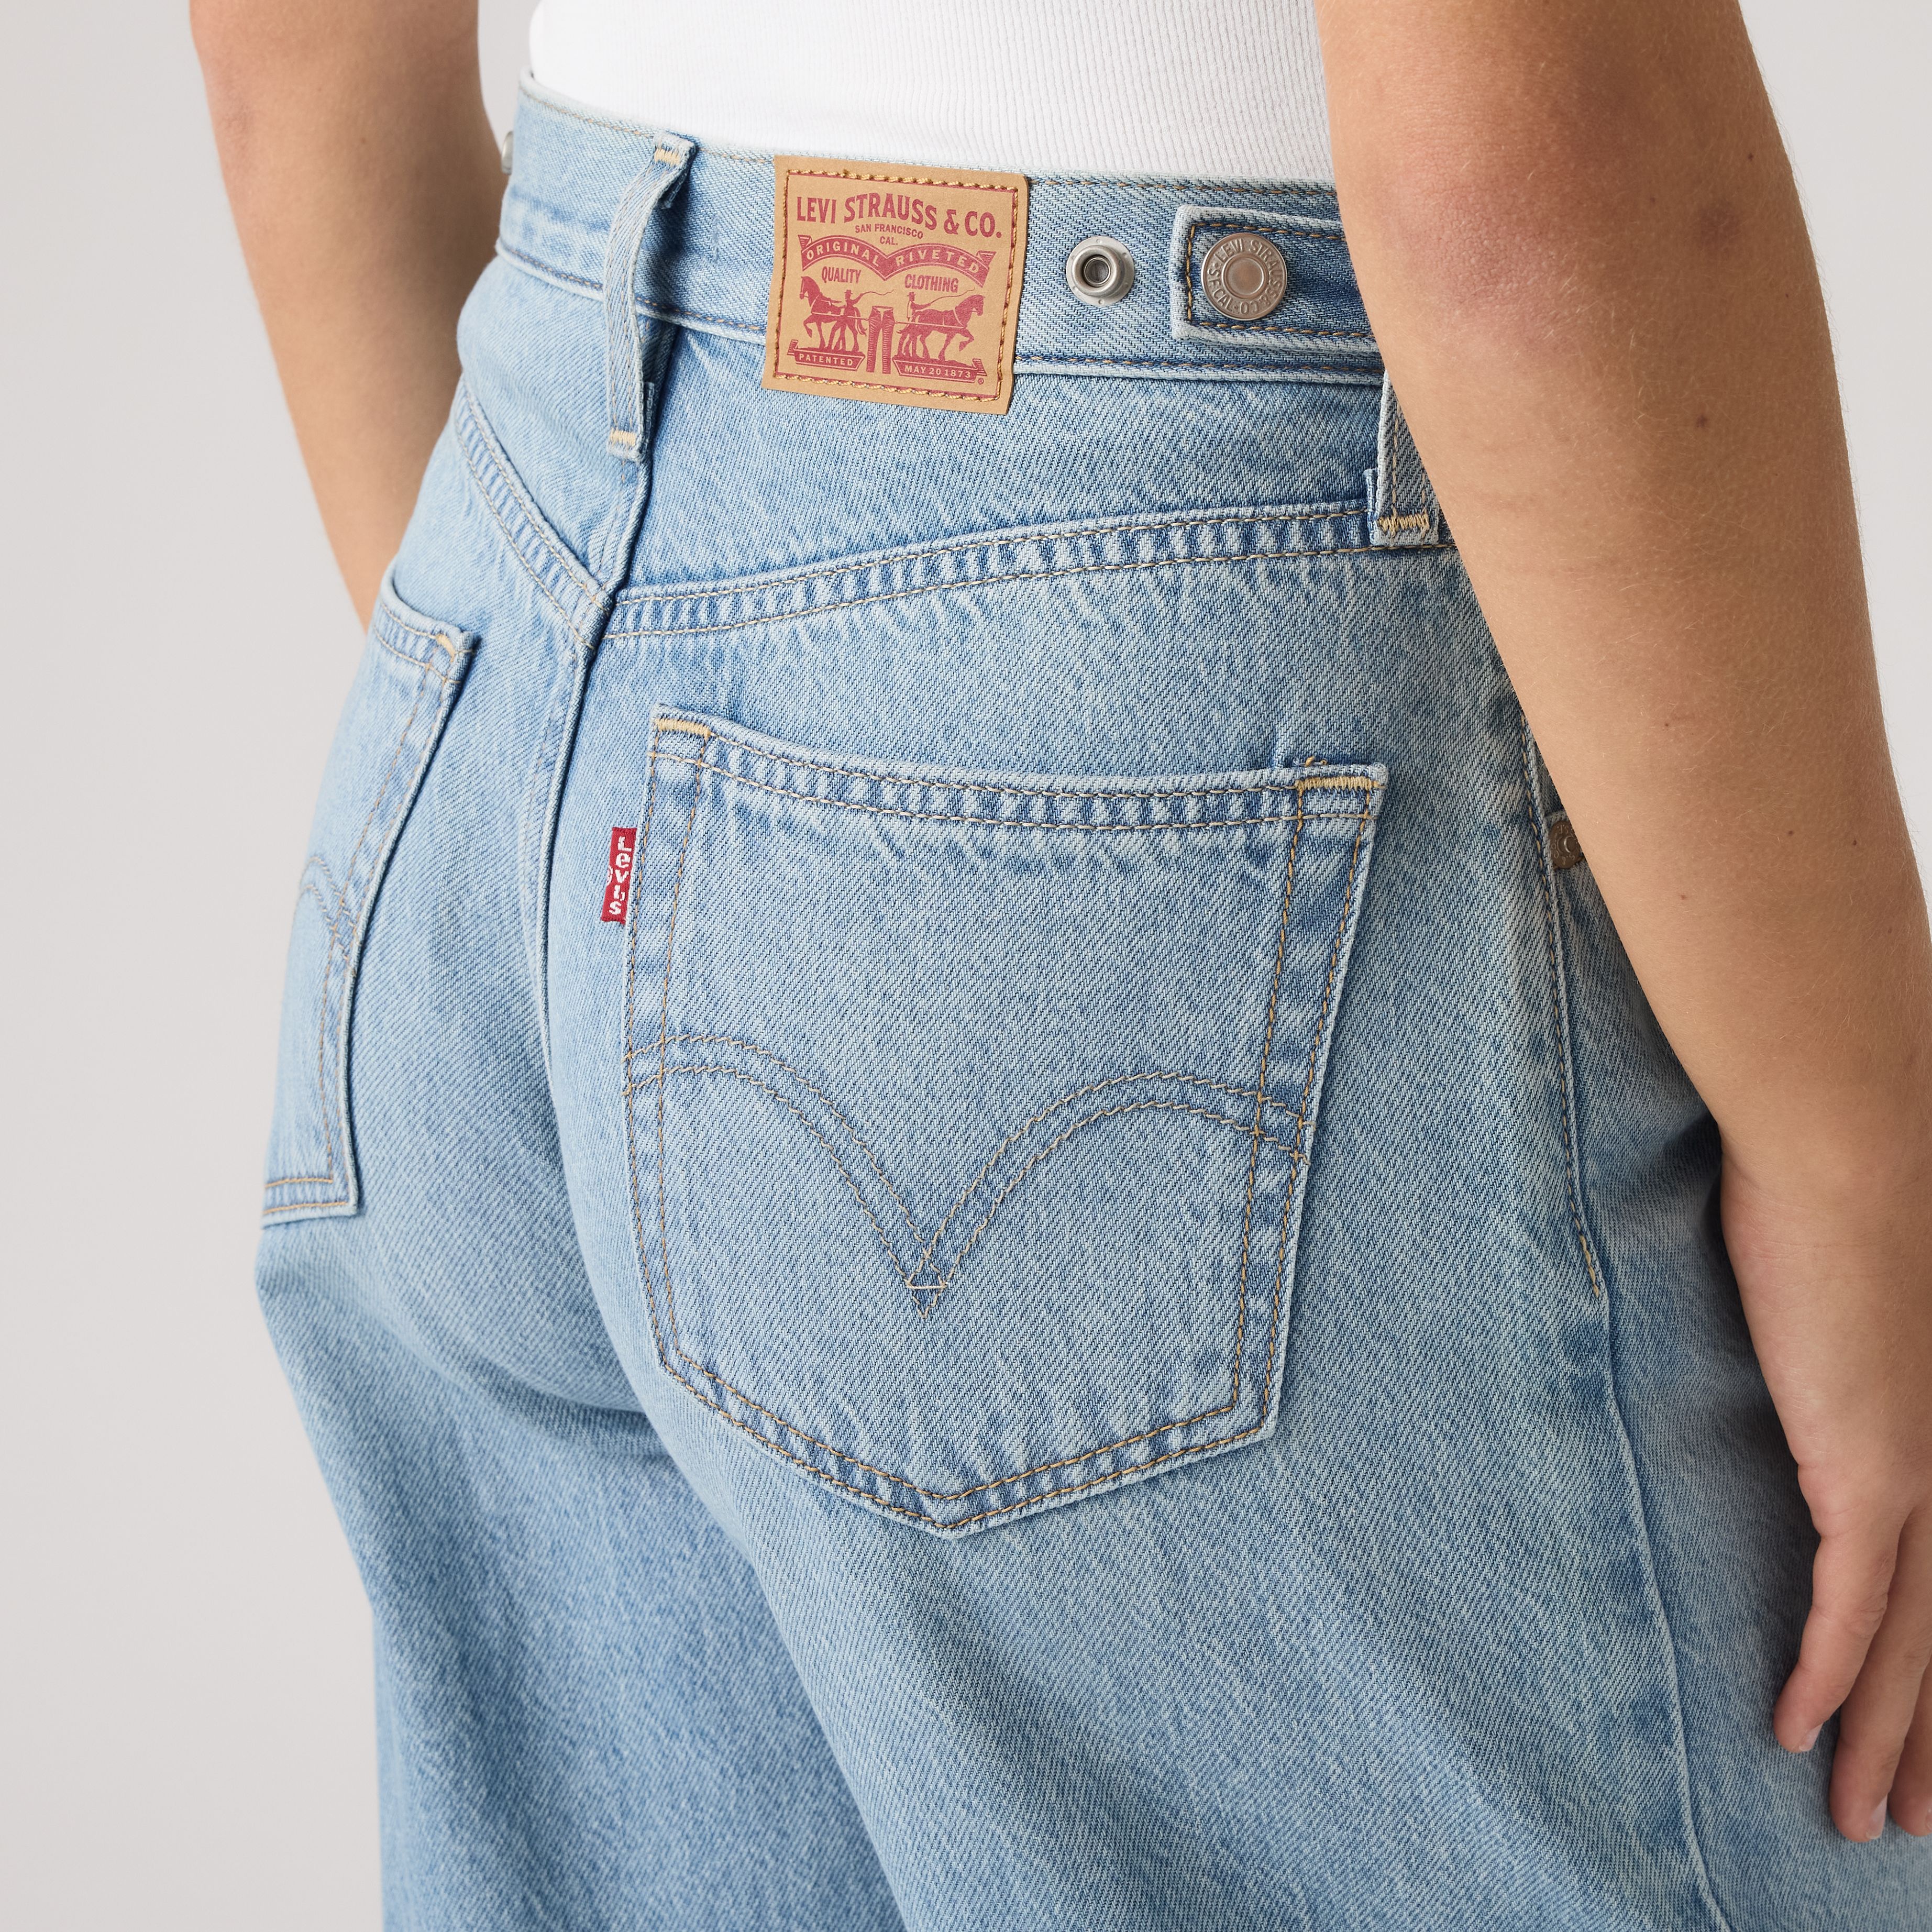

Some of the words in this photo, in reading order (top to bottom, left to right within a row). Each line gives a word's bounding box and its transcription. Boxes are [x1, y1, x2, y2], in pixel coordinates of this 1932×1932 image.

[797, 196, 837, 224] LEVI
[844, 192, 937, 230] STRAUSS
[943, 209, 960, 235] &
[964, 211, 1002, 238] CO.
[855, 224, 871, 233] SAN
[874, 223, 923, 239] FRANCISCO
[879, 236, 899, 246] CAL.
[806, 241, 880, 267] ORIGINAL
[895, 249, 980, 273] RIVETED
[1214, 238, 1244, 262] LEVI
[821, 266, 862, 284] QUALITY
[904, 273, 959, 293] CLOTHING
[799, 353, 854, 366] PATENTED
[904, 365, 926, 373] MAY
[929, 367, 942, 376] 20
[944, 369, 971, 378] 1873
